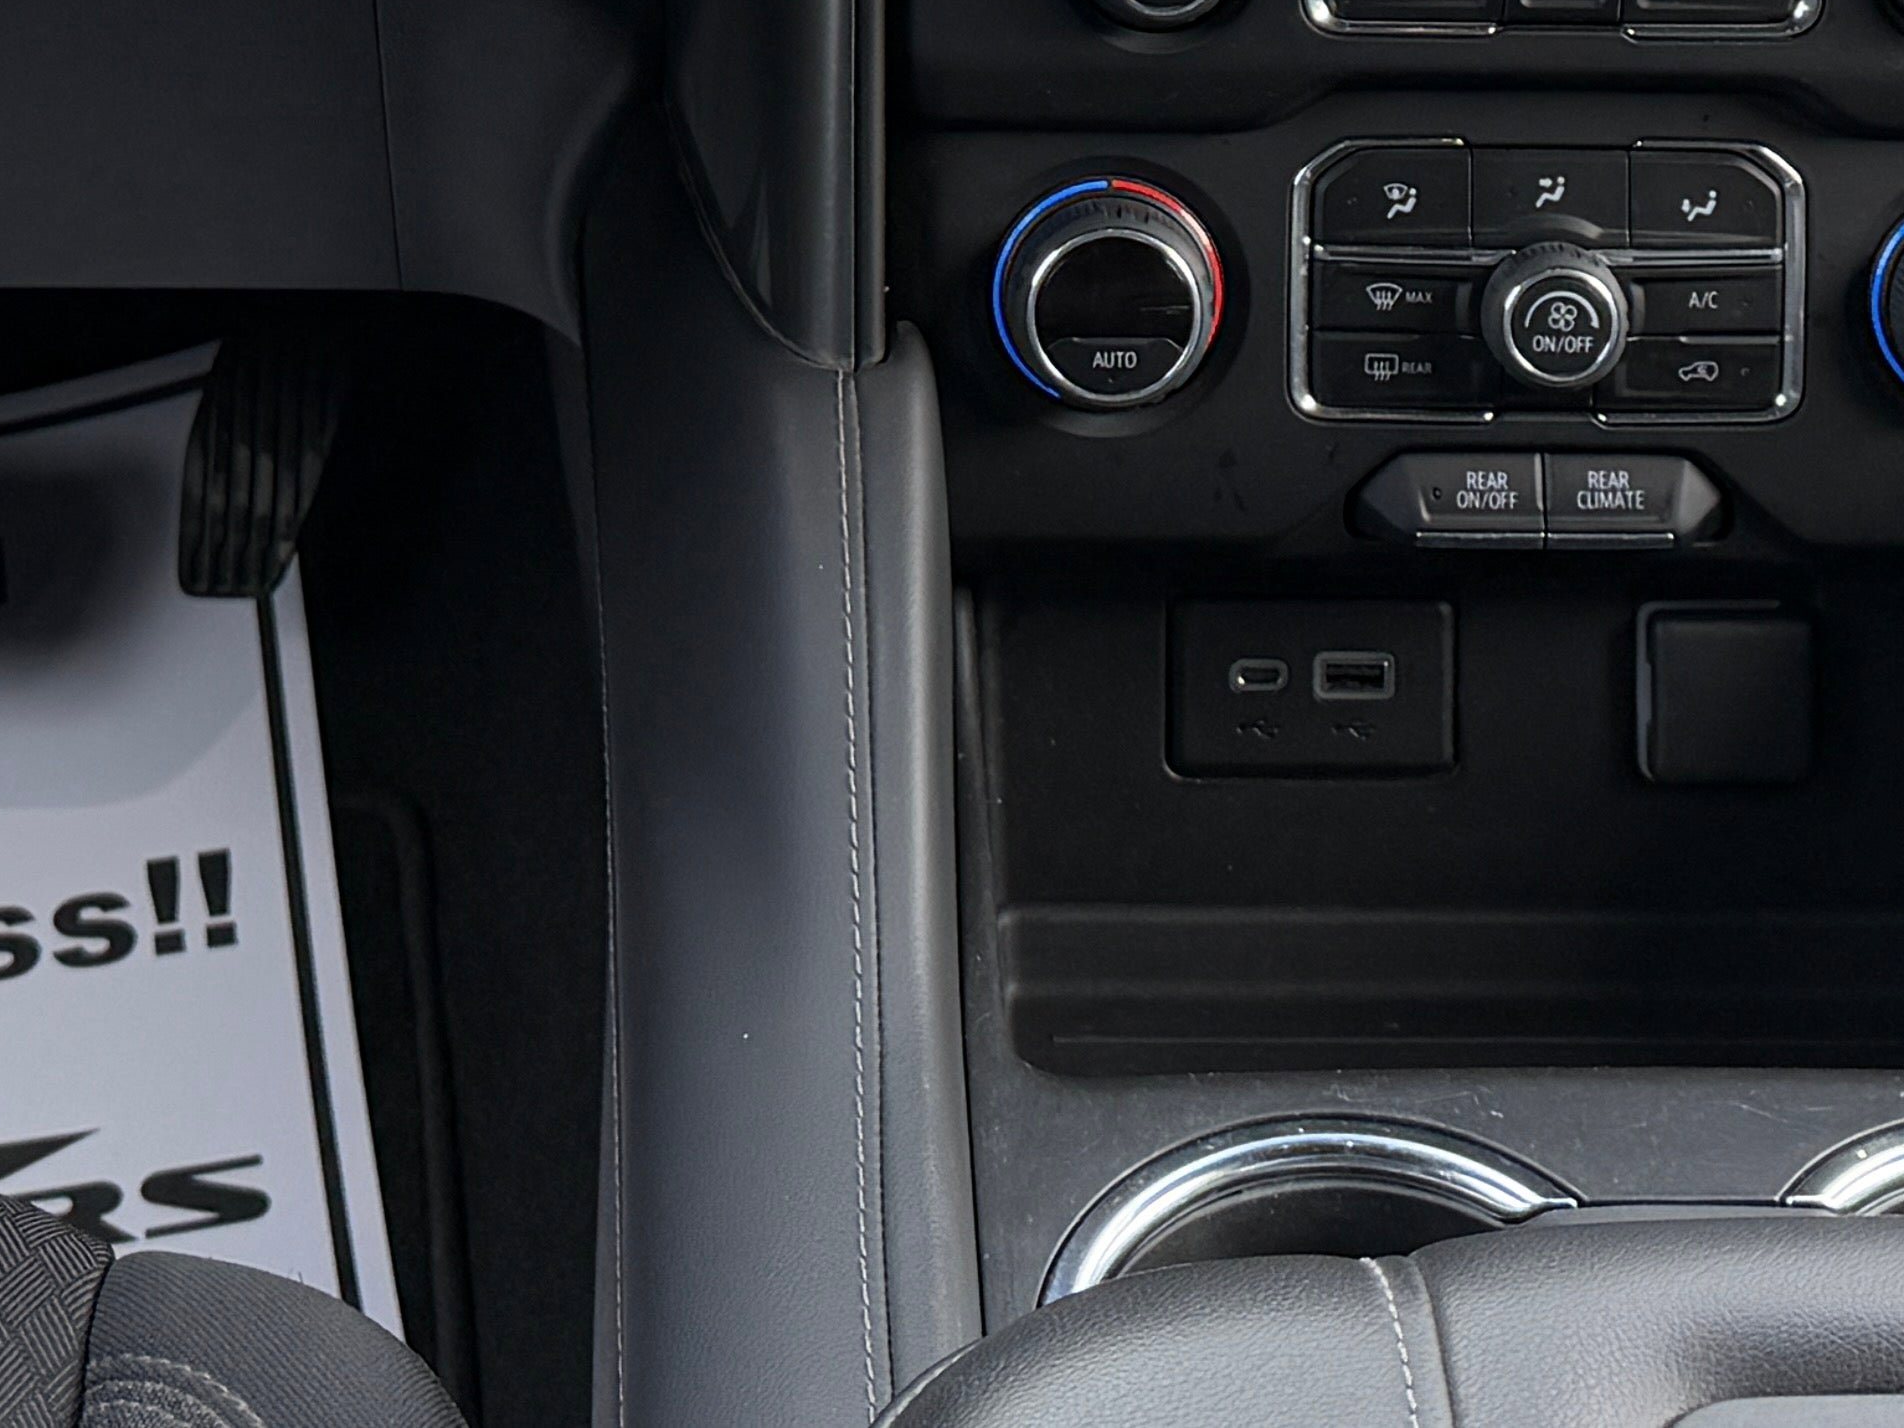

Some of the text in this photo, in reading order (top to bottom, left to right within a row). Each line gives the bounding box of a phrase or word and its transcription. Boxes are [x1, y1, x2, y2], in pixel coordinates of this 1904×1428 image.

[1405, 291, 1433, 305] MAX
[1688, 290, 1720, 309] A/C
[1531, 335, 1595, 354] ON/OFF
[1092, 351, 1138, 369] AUTO
[1401, 360, 1433, 375] REAR
[1466, 471, 1509, 490] REAR
[1587, 470, 1631, 489] REAR
[1456, 491, 1520, 510] ON/OFF
[1576, 490, 1646, 510] CLIMATE
